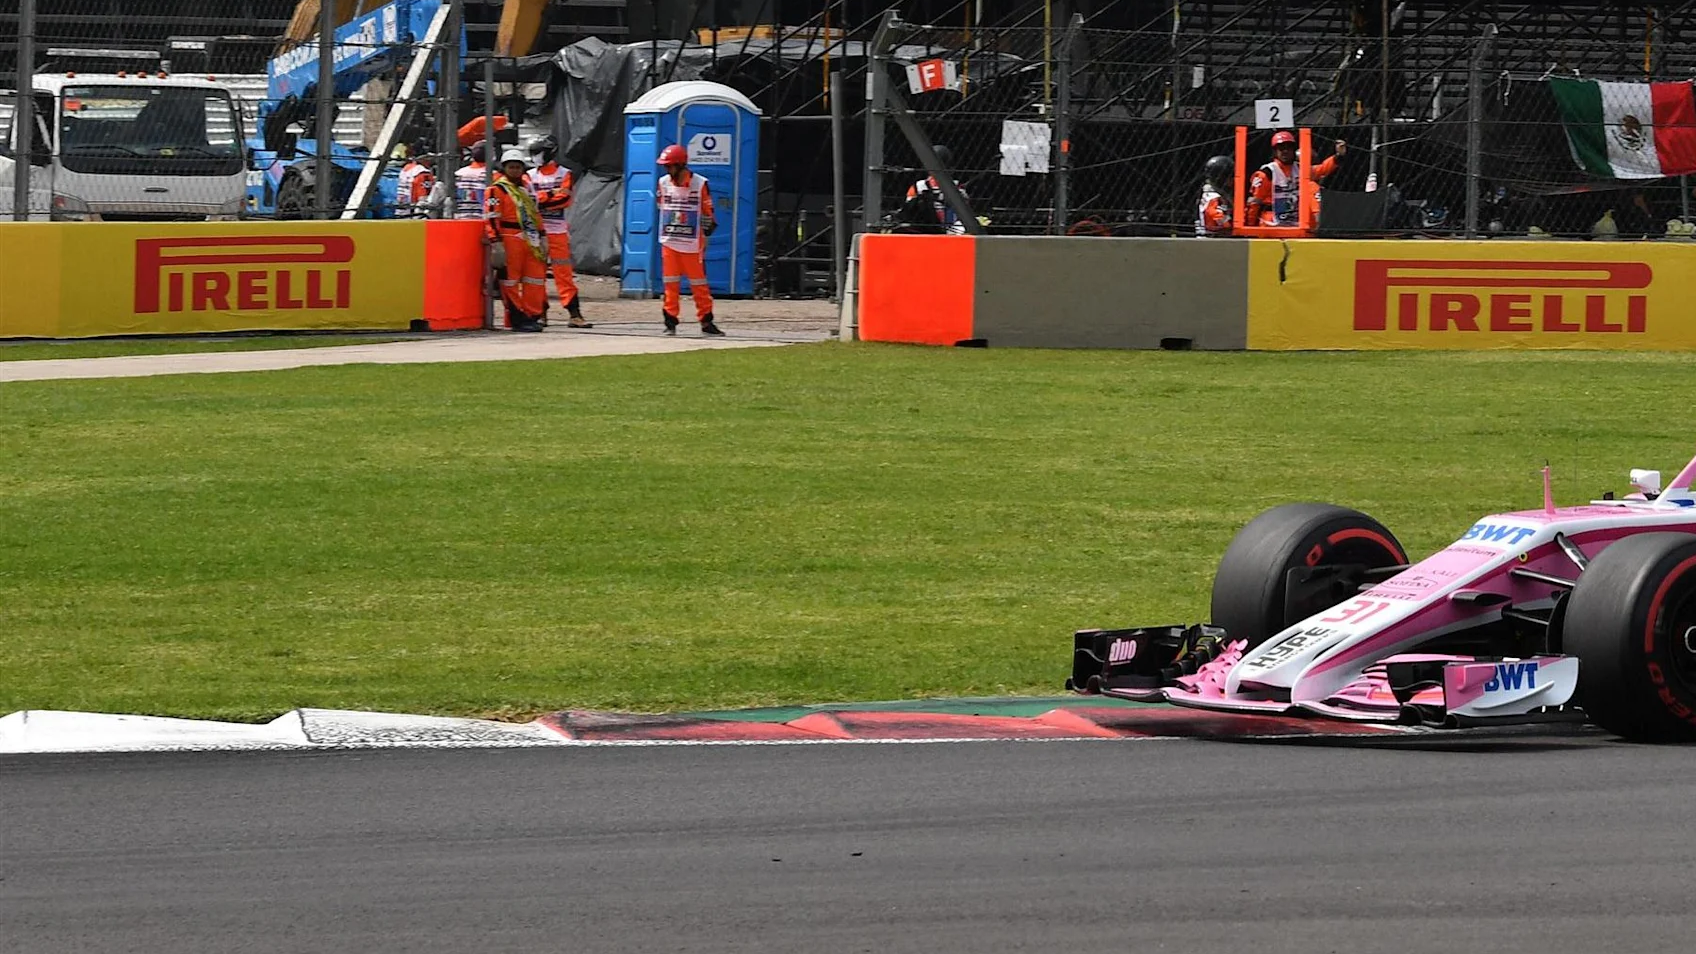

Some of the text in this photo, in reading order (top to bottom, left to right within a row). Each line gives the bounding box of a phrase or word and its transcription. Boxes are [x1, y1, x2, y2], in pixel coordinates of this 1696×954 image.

[921, 63, 936, 88] F
[1268, 106, 1281, 123] 2
[134, 235, 356, 314] PIRELLI
[1353, 258, 1653, 333] PIRELLI
[1461, 523, 1538, 546] BWT
[1321, 600, 1391, 625] 31
[1109, 637, 1138, 662] duo
[1248, 626, 1331, 668] HYPE
